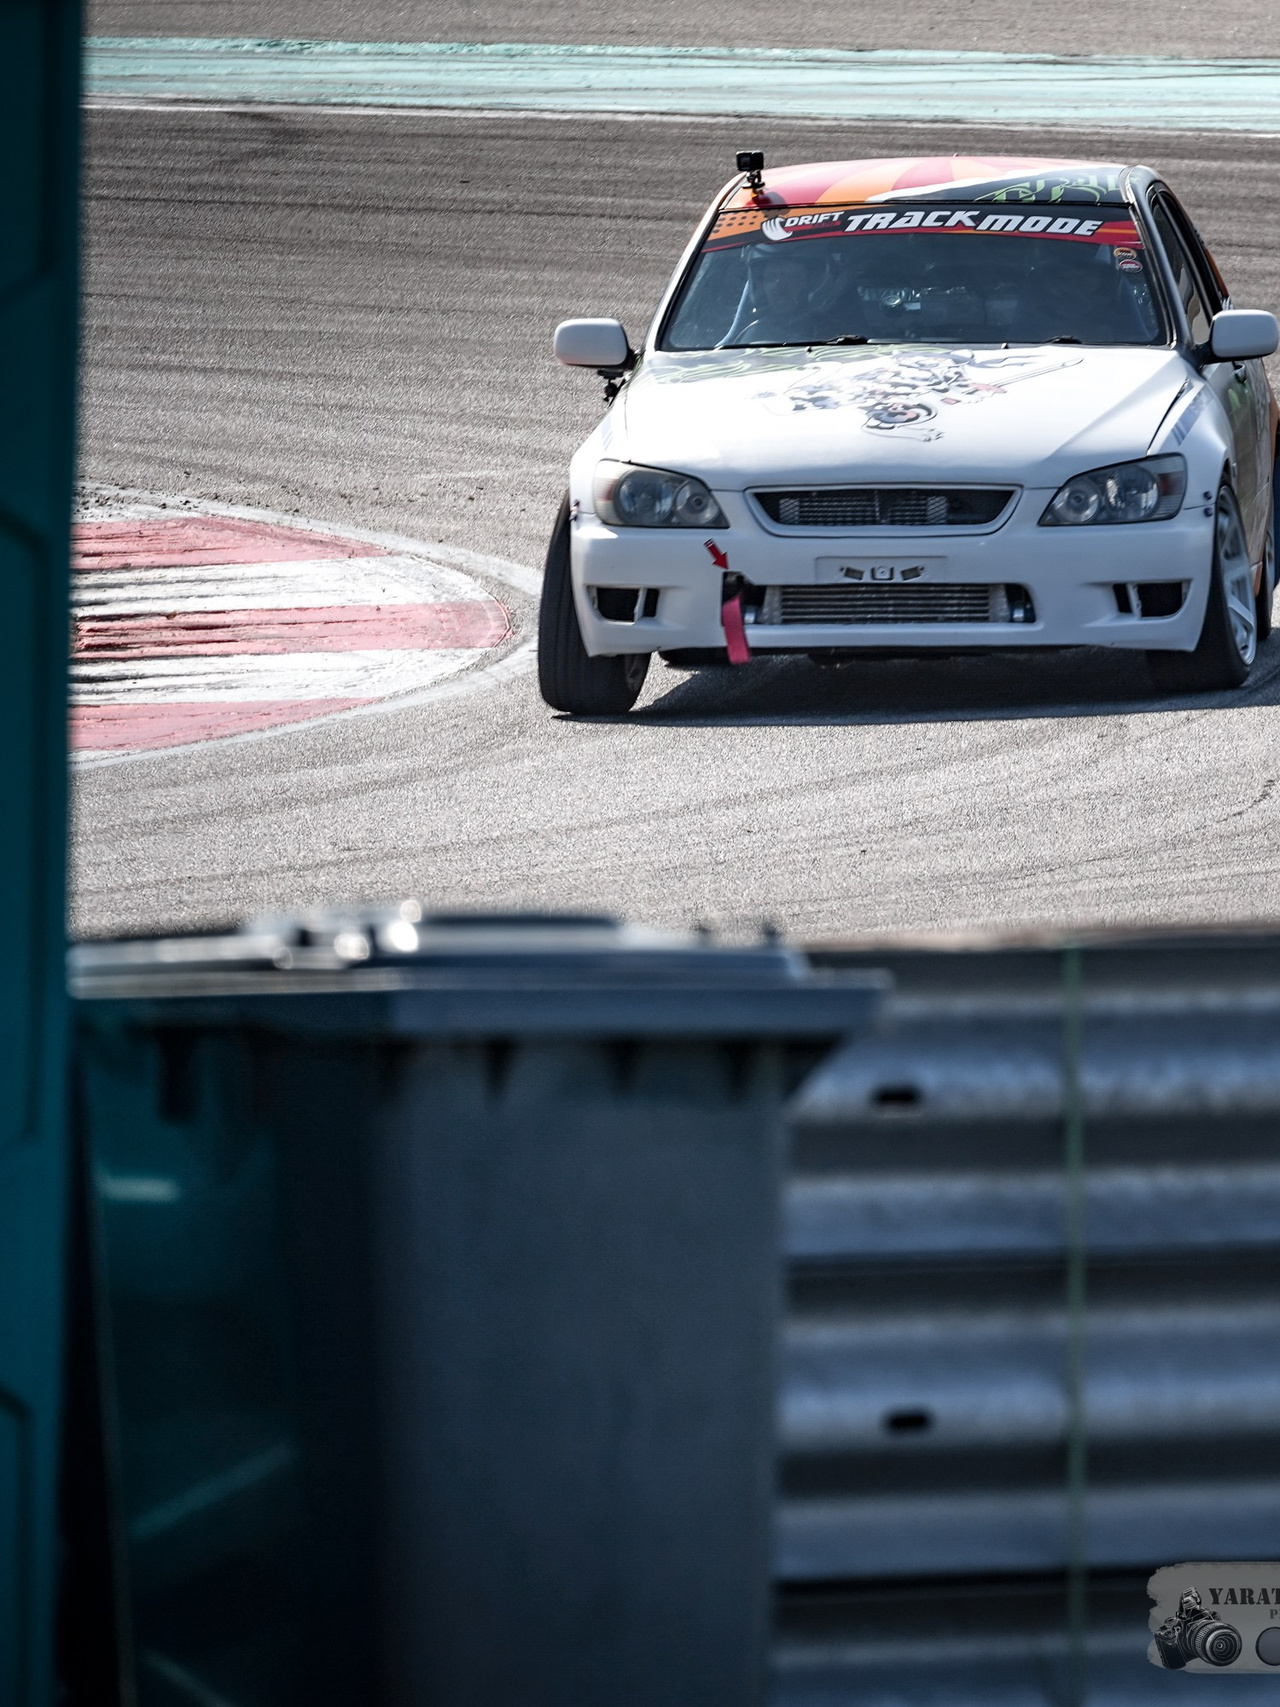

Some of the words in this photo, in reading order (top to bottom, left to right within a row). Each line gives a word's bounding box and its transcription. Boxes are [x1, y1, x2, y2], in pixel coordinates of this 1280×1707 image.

[785, 211, 845, 227] DRIFT
[844, 211, 980, 232] TRACK
[975, 215, 1103, 236] MODE
